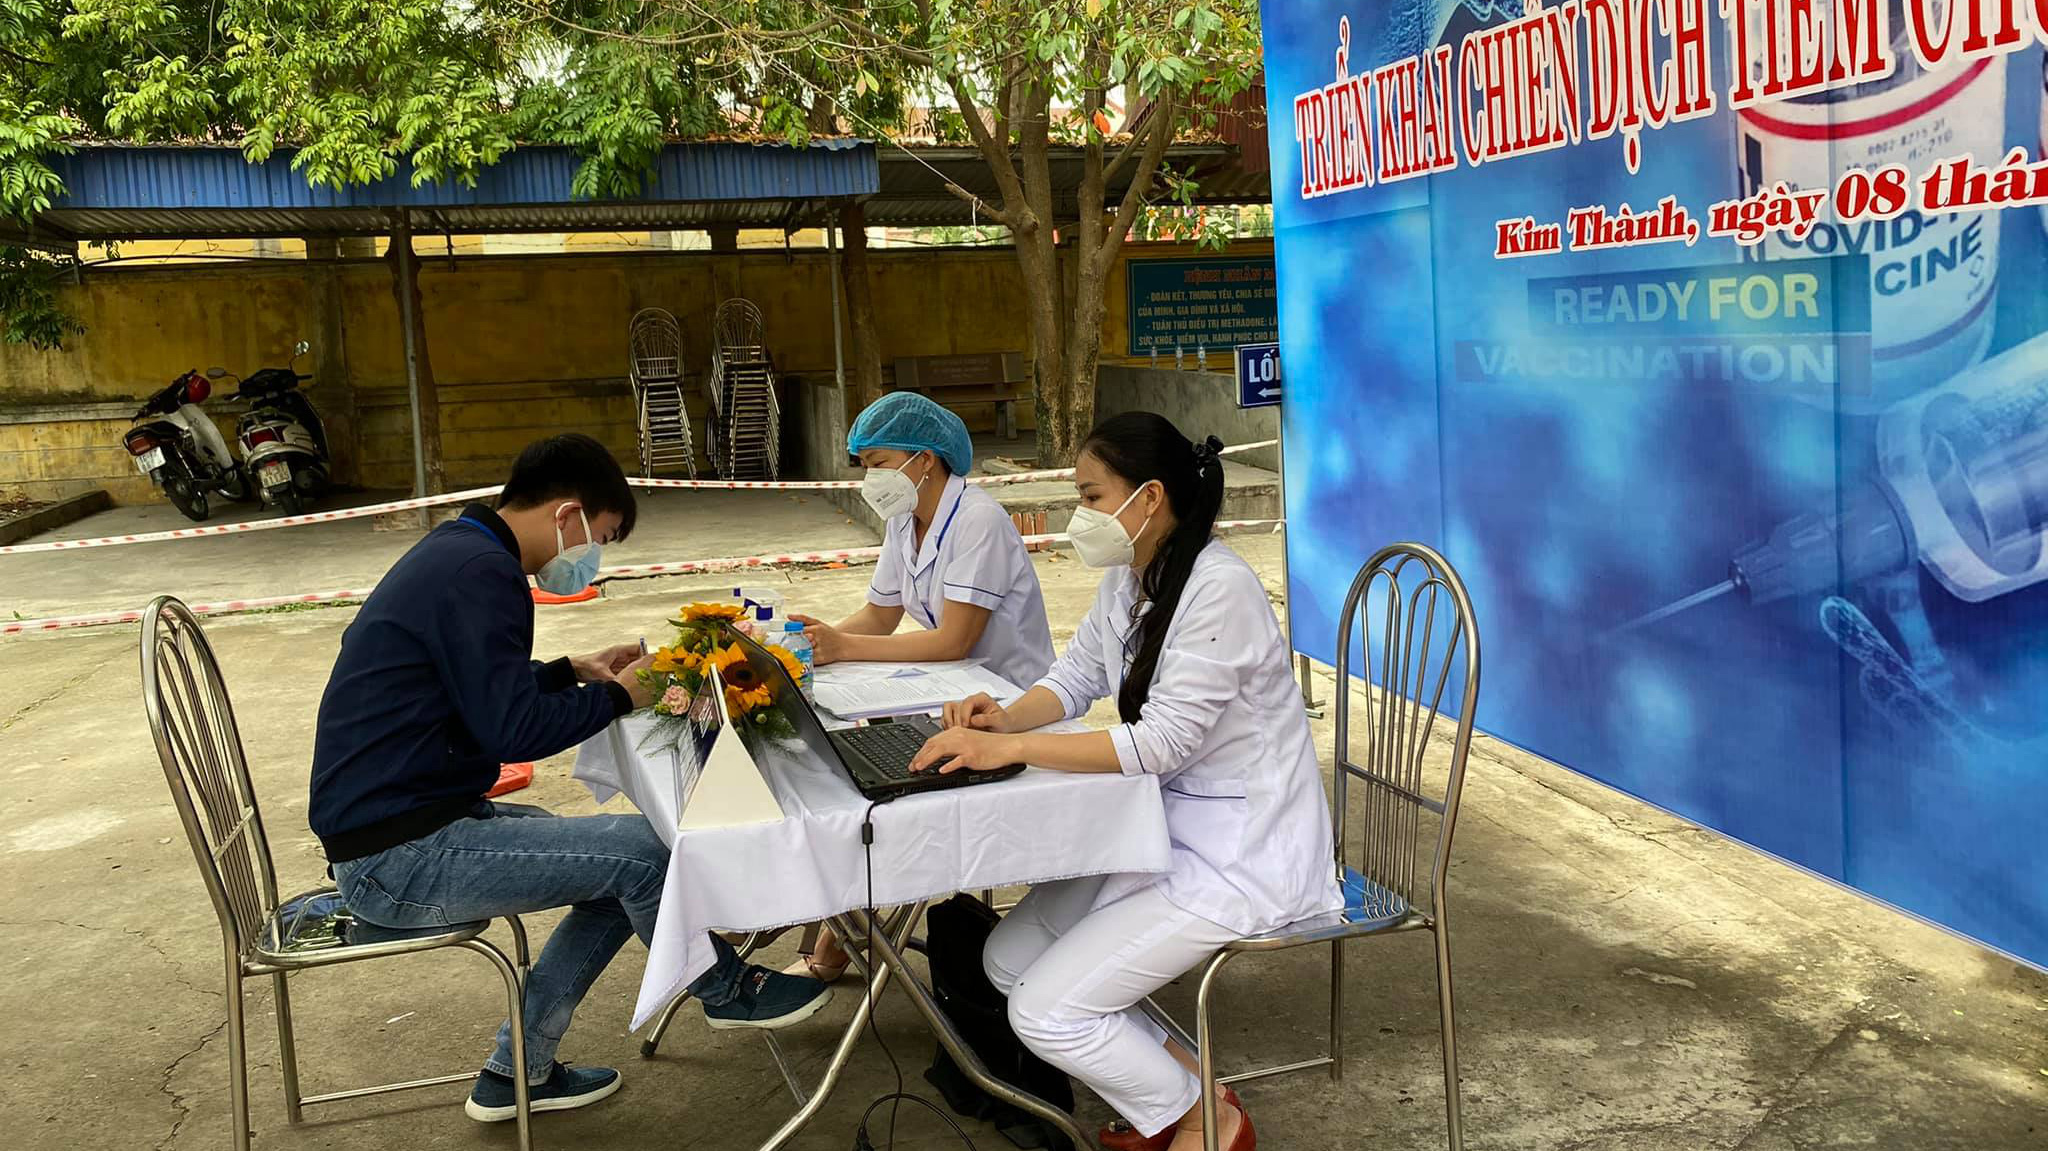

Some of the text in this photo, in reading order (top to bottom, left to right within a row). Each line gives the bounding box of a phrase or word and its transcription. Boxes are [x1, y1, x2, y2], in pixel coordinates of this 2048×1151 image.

[1295, 17, 1373, 196] TRIỂN
[1375, 48, 1455, 179] KHAI
[1585, 0, 1711, 168] DỊCH
[1496, 218, 1560, 256] Kim
[1569, 199, 1698, 248] Thành,
[1709, 184, 1826, 241] ngày
[1835, 168, 1907, 219] 08
[1776, 208, 1958, 255] COVID-
[1177, 305, 1189, 315] GIA
[1235, 289, 1252, 299] CHIA
[1553, 272, 1821, 325] READY FOR
[1473, 342, 1836, 384] VACCINATION
